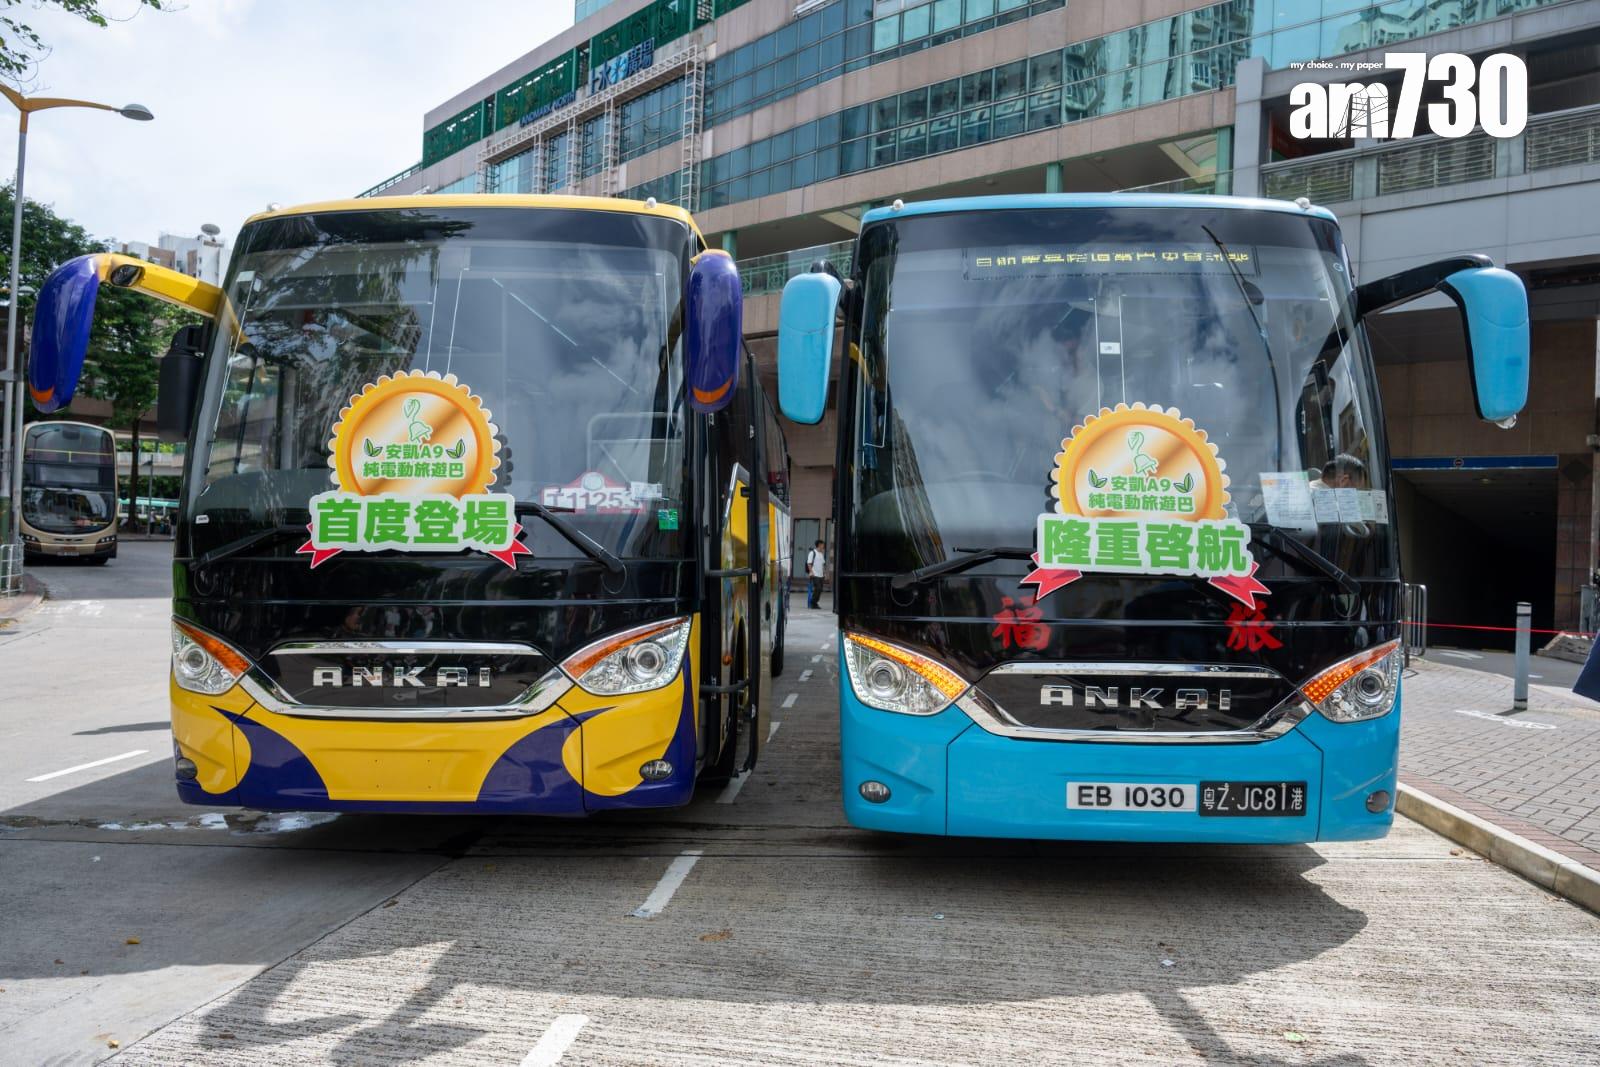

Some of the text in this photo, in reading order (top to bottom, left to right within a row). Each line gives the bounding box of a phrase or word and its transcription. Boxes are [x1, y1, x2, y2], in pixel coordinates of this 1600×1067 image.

[386, 444, 444, 460] 安凱A9
[363, 461, 465, 478] 純電動旅遊巴
[1111, 475, 1172, 493] 安凱A9
[1088, 492, 1195, 513] 純電動旅遊巴
[316, 498, 509, 546] 首度登場
[992, 596, 1284, 652] 福 旅
[313, 666, 492, 687] ANKAI
[1040, 684, 1232, 711] ANKAI
[1077, 785, 1185, 808] EB 1030
